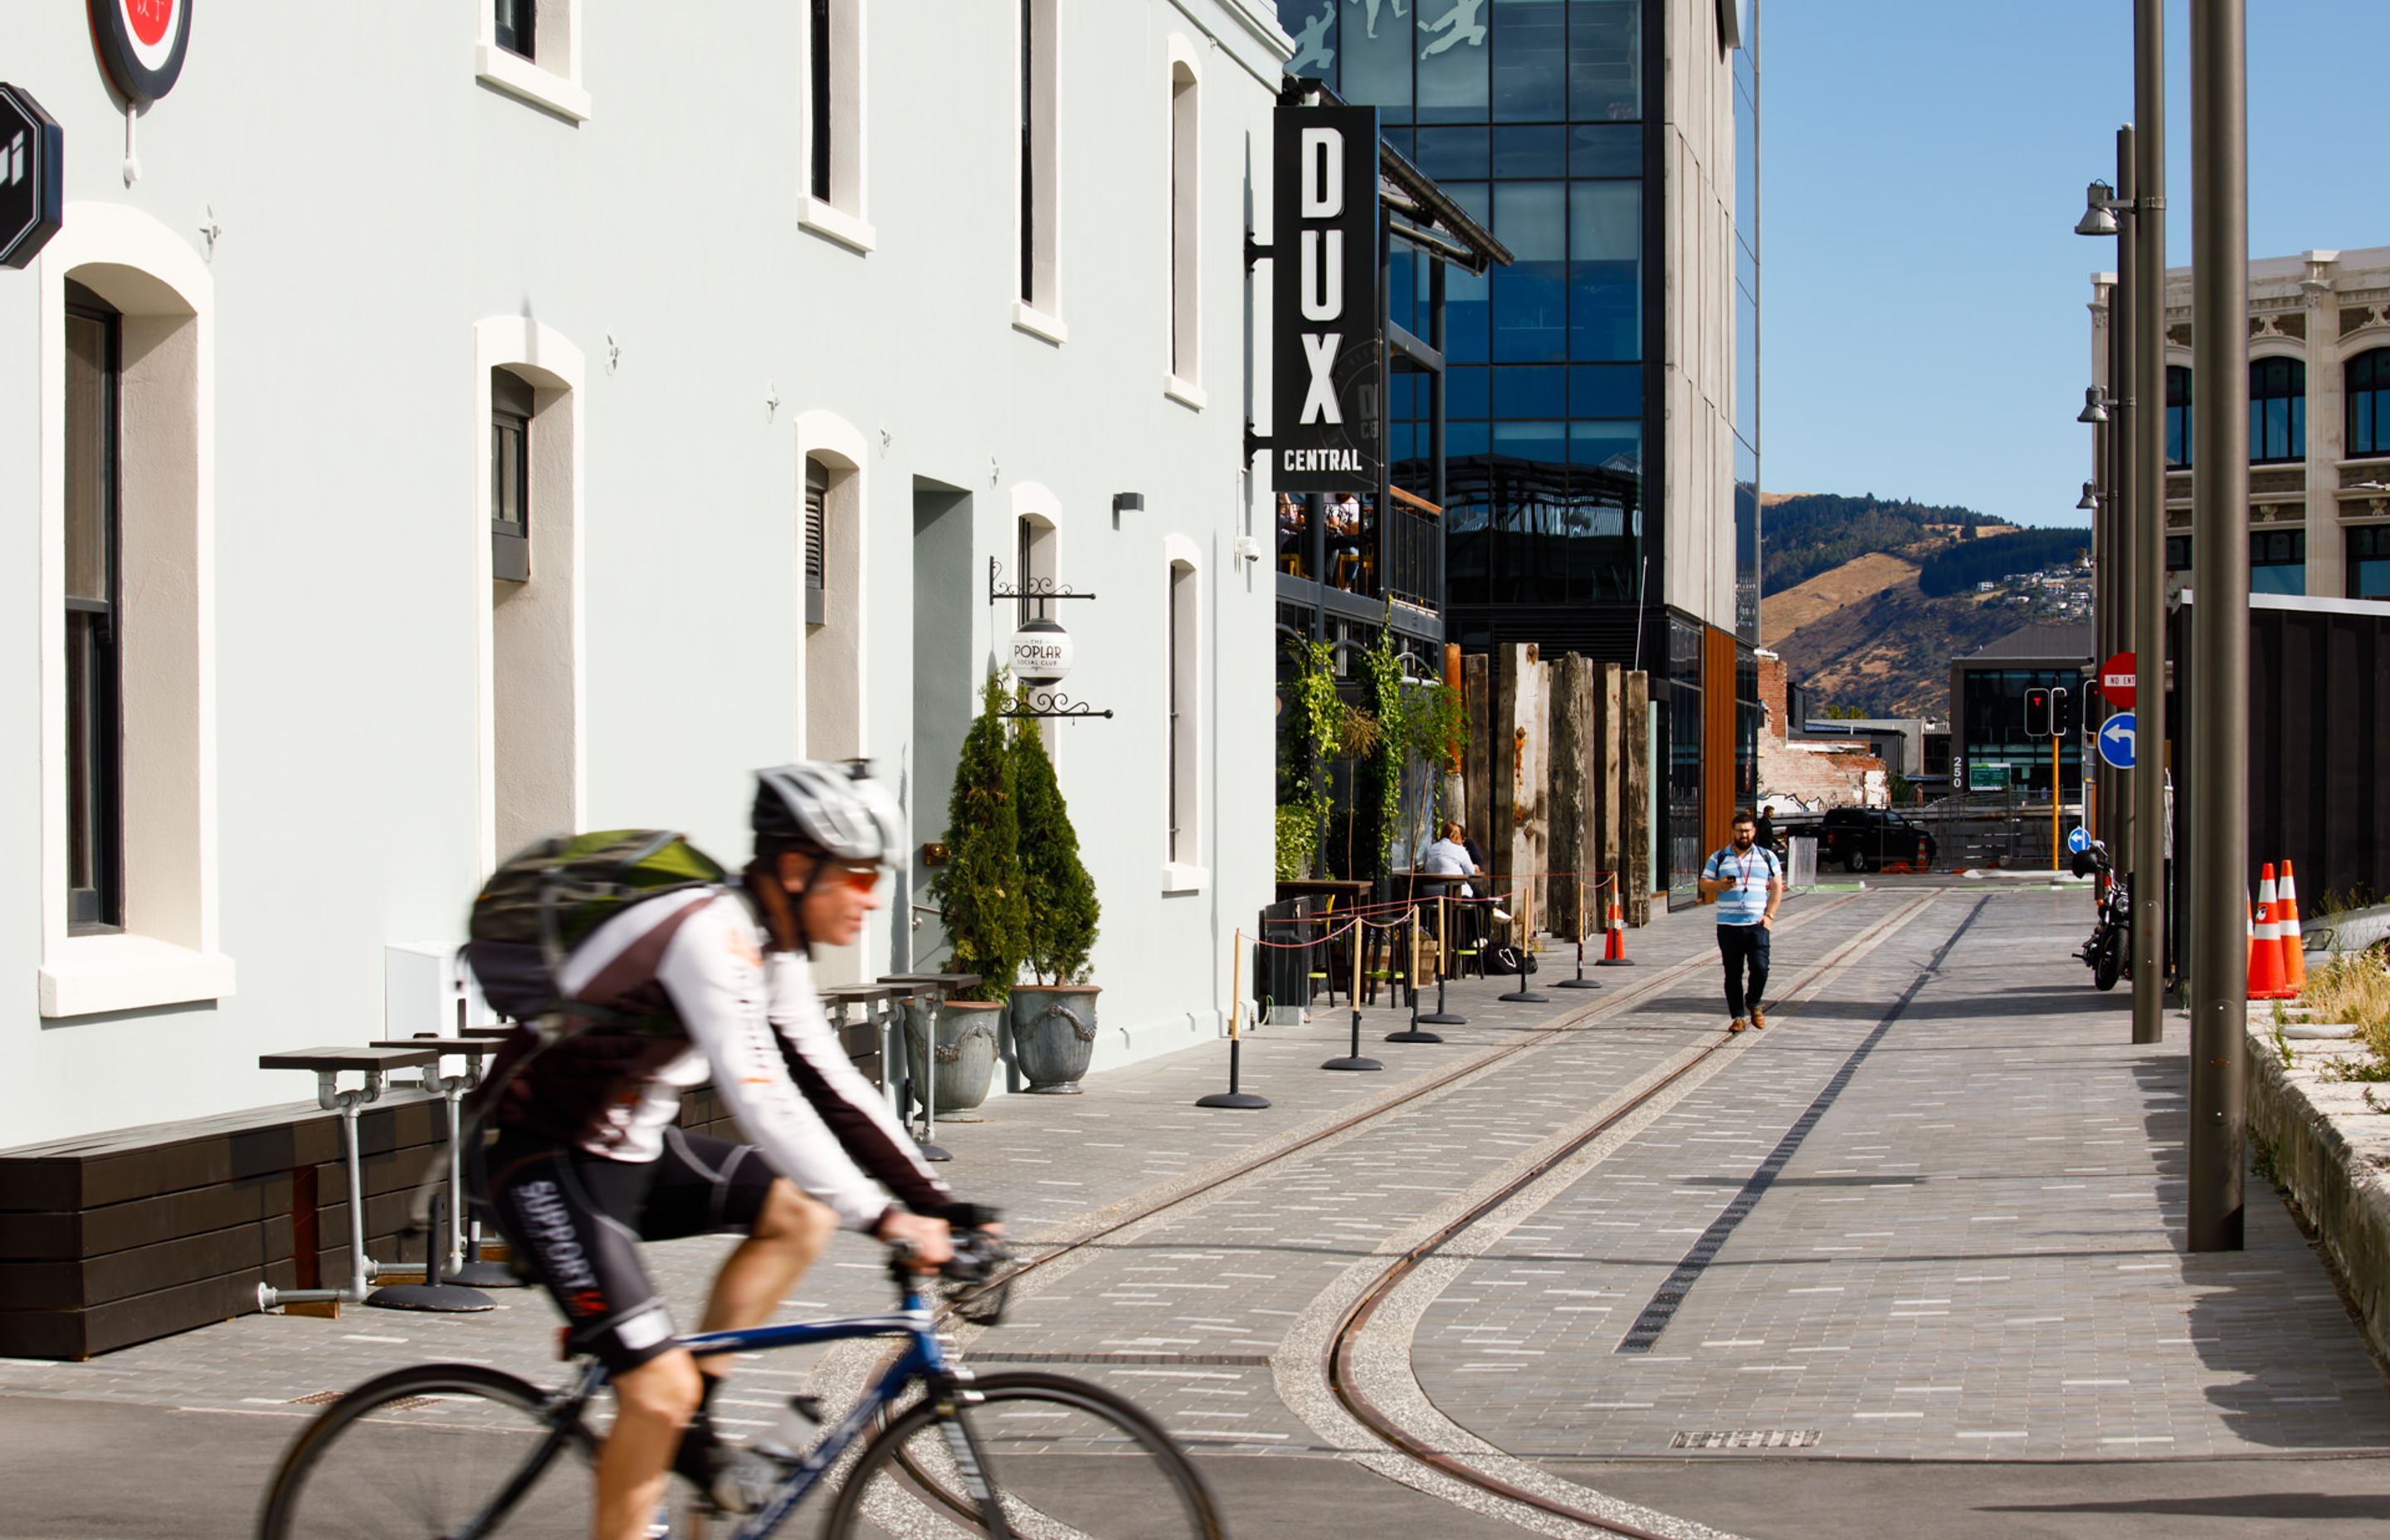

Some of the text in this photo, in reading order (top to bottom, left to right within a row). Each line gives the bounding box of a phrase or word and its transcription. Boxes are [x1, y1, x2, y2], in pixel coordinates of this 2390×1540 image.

[1300, 127, 1344, 424] DUX
[1284, 449, 1363, 471] CENTRAL
[1014, 645, 1061, 659] POPLAR
[2110, 676, 2119, 685] NO
[1953, 756, 1962, 788] 250
